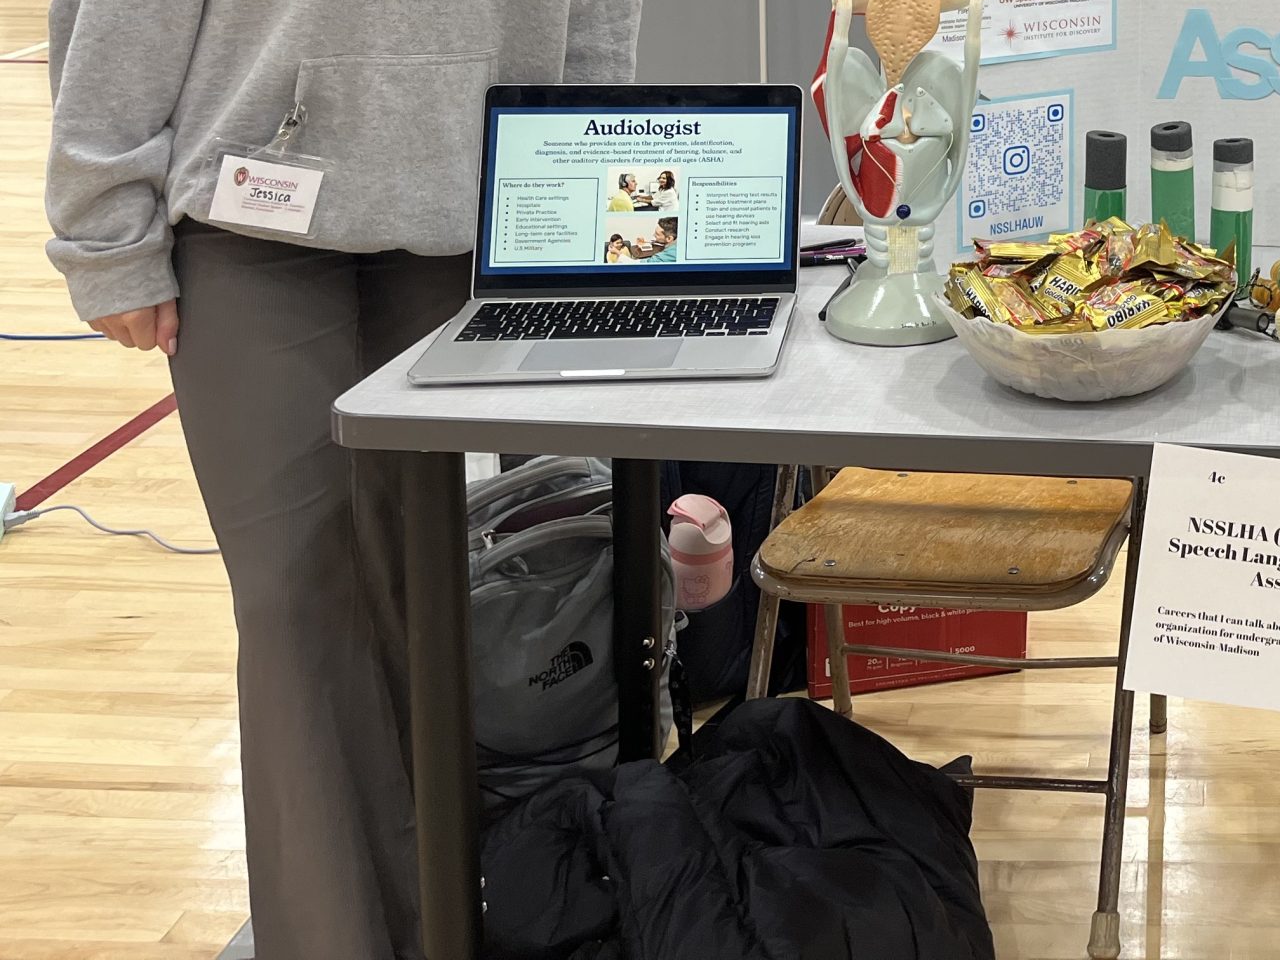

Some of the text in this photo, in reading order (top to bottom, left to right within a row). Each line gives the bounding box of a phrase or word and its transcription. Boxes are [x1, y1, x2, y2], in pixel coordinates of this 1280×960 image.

[1023, 15, 1100, 32] WISCONSIN
[1023, 32, 1053, 40] INSTITUTE
[1068, 28, 1100, 36] DISCOVERY
[583, 118, 701, 139] Audiologist
[245, 175, 298, 189] WISCONSIN
[249, 187, 291, 203] Jessica
[990, 215, 1043, 235] NSSLHAUW
[1106, 299, 1153, 329] HARIBO
[1208, 471, 1225, 483] 4c
[1188, 517, 1267, 542] NSSLHA
[1168, 537, 1236, 560] Speech
[1157, 606, 1197, 619] Careers
[1198, 611, 1218, 622] that
[1220, 614, 1224, 623] I
[1226, 617, 1243, 626] can
[1245, 618, 1264, 629] talk
[550, 646, 570, 666] THE
[528, 657, 571, 687] NORTH
[542, 667, 573, 691] FACE
